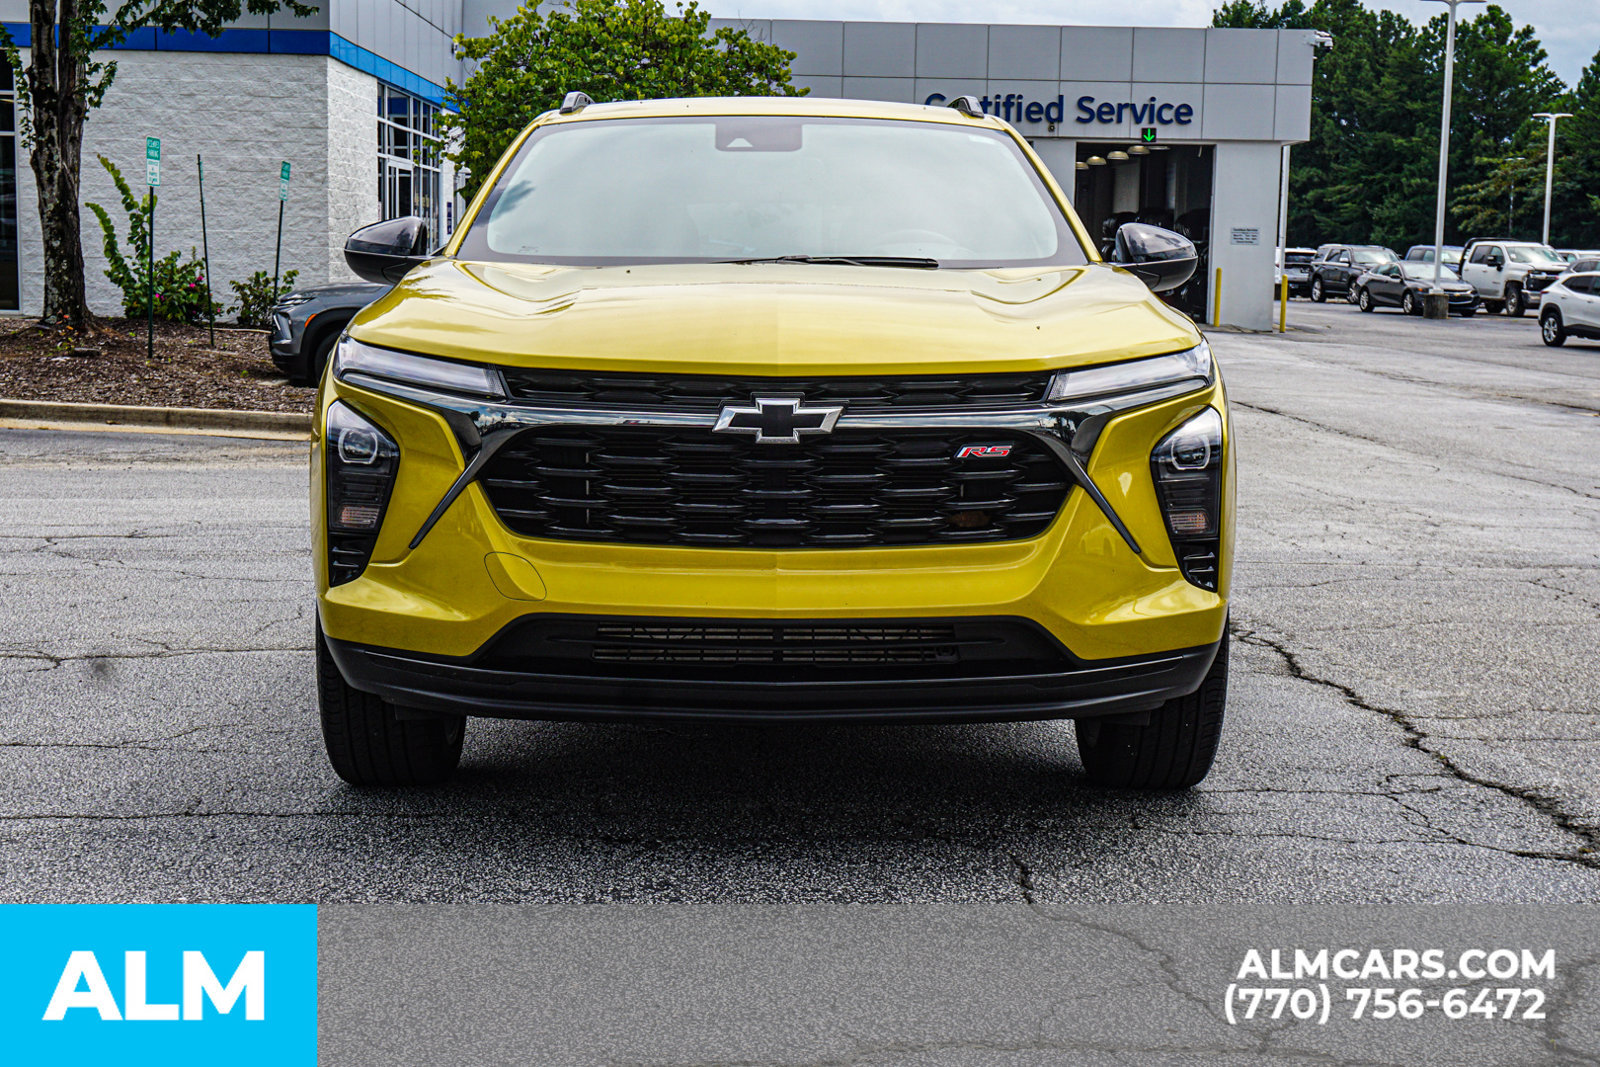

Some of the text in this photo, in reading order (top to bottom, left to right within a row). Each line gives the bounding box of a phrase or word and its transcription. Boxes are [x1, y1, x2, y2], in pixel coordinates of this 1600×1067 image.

[924, 93, 1194, 125] tified Service
[956, 445, 1012, 458] RS
